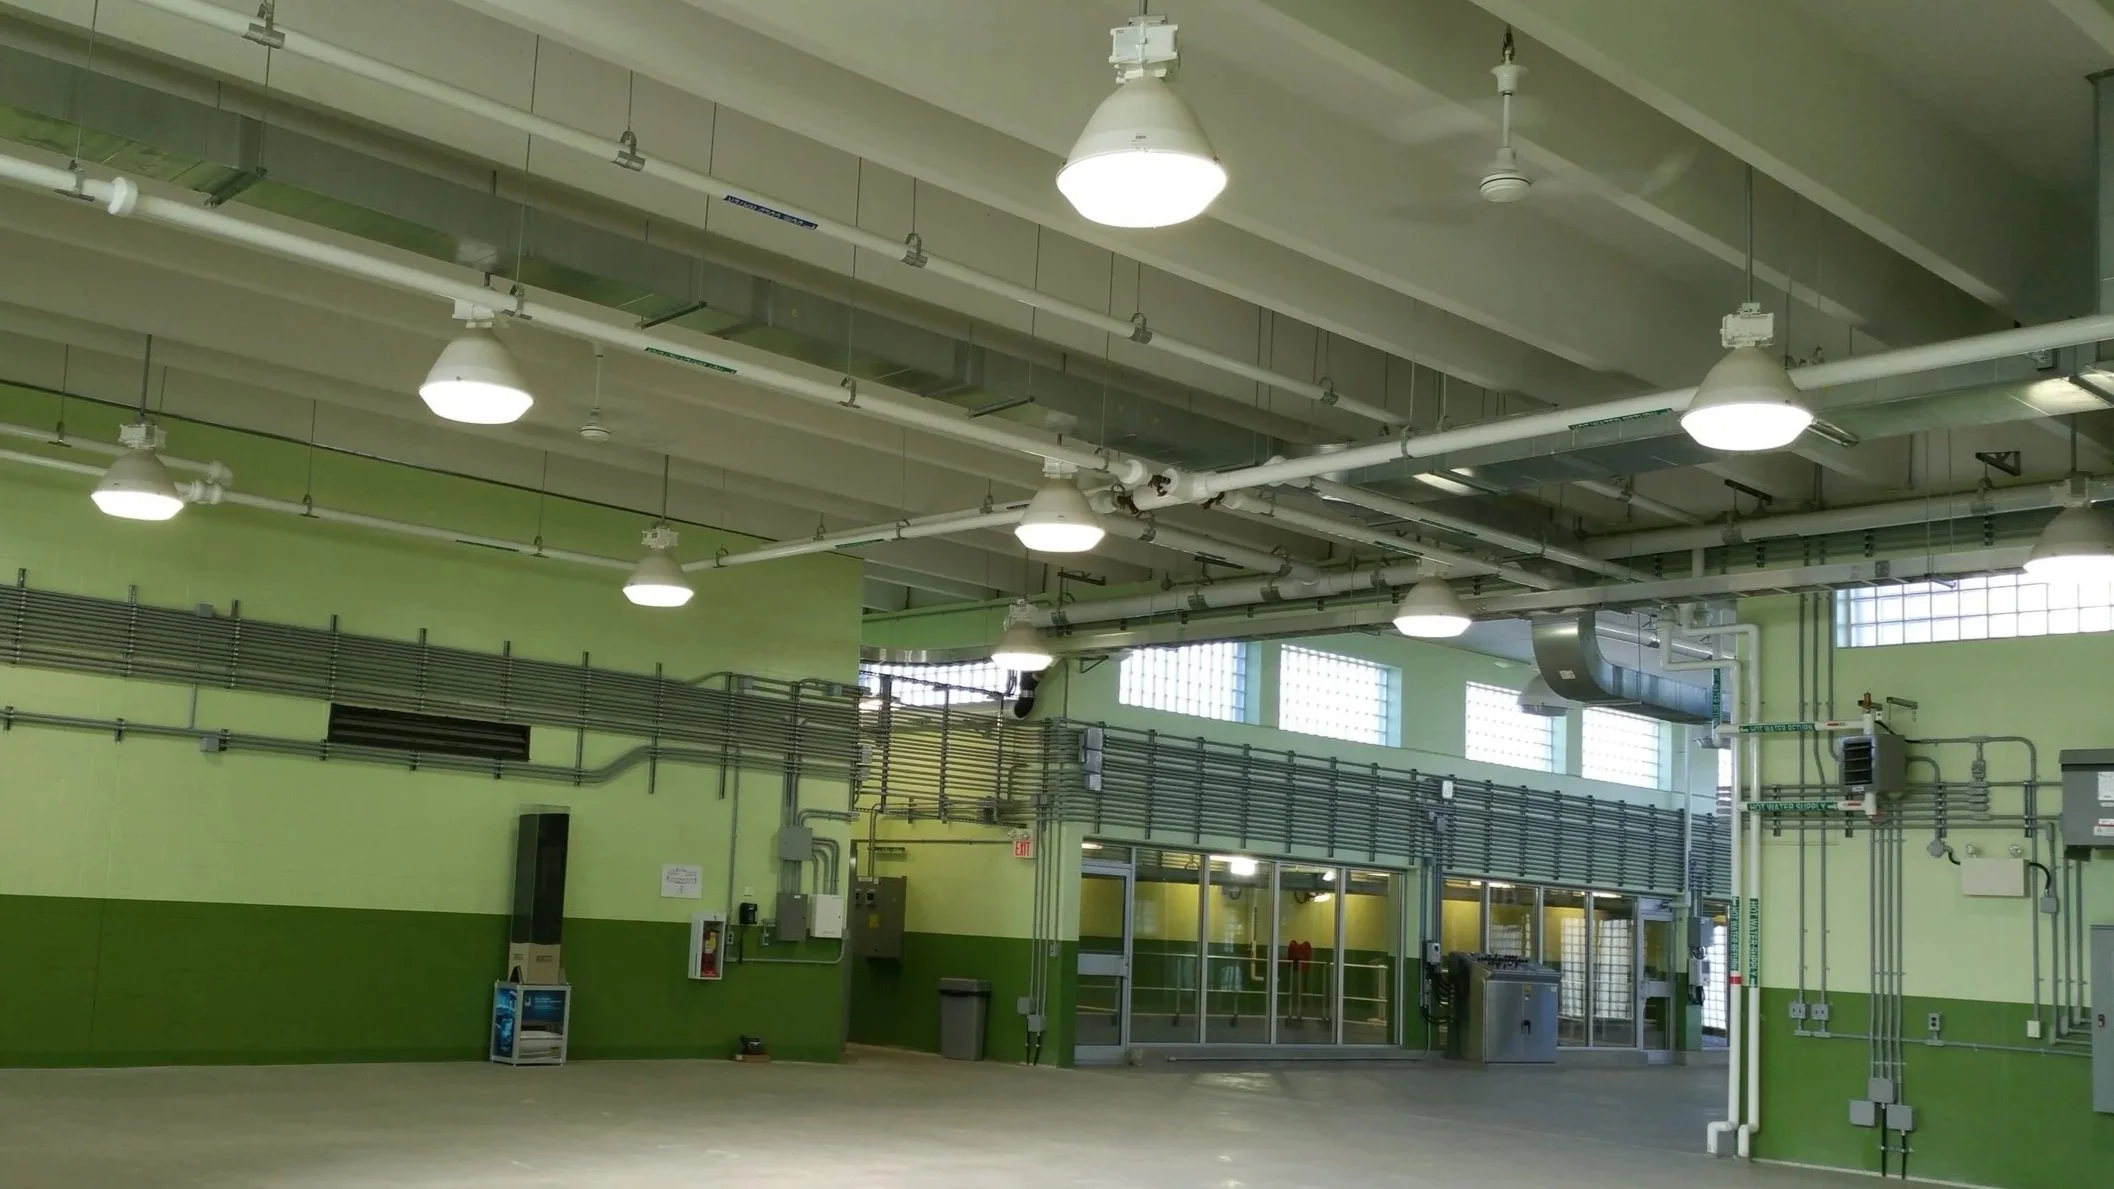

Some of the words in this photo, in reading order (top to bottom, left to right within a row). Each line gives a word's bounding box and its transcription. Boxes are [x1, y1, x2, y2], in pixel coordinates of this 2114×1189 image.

[1764, 724, 1787, 733] WATER
[1749, 803, 1765, 811] HOT
[1767, 803, 1794, 811] WATER
[1796, 802, 1826, 811] SUPPLY
[1015, 841, 1031, 856] EXIT
[1731, 907, 1739, 919] HOT
[1750, 901, 1758, 918] HOT
[1731, 921, 1739, 944] WATER
[1750, 920, 1758, 945] WATER
[1730, 944, 1738, 970] RETURN
[1750, 946, 1758, 977] SUPPLY
